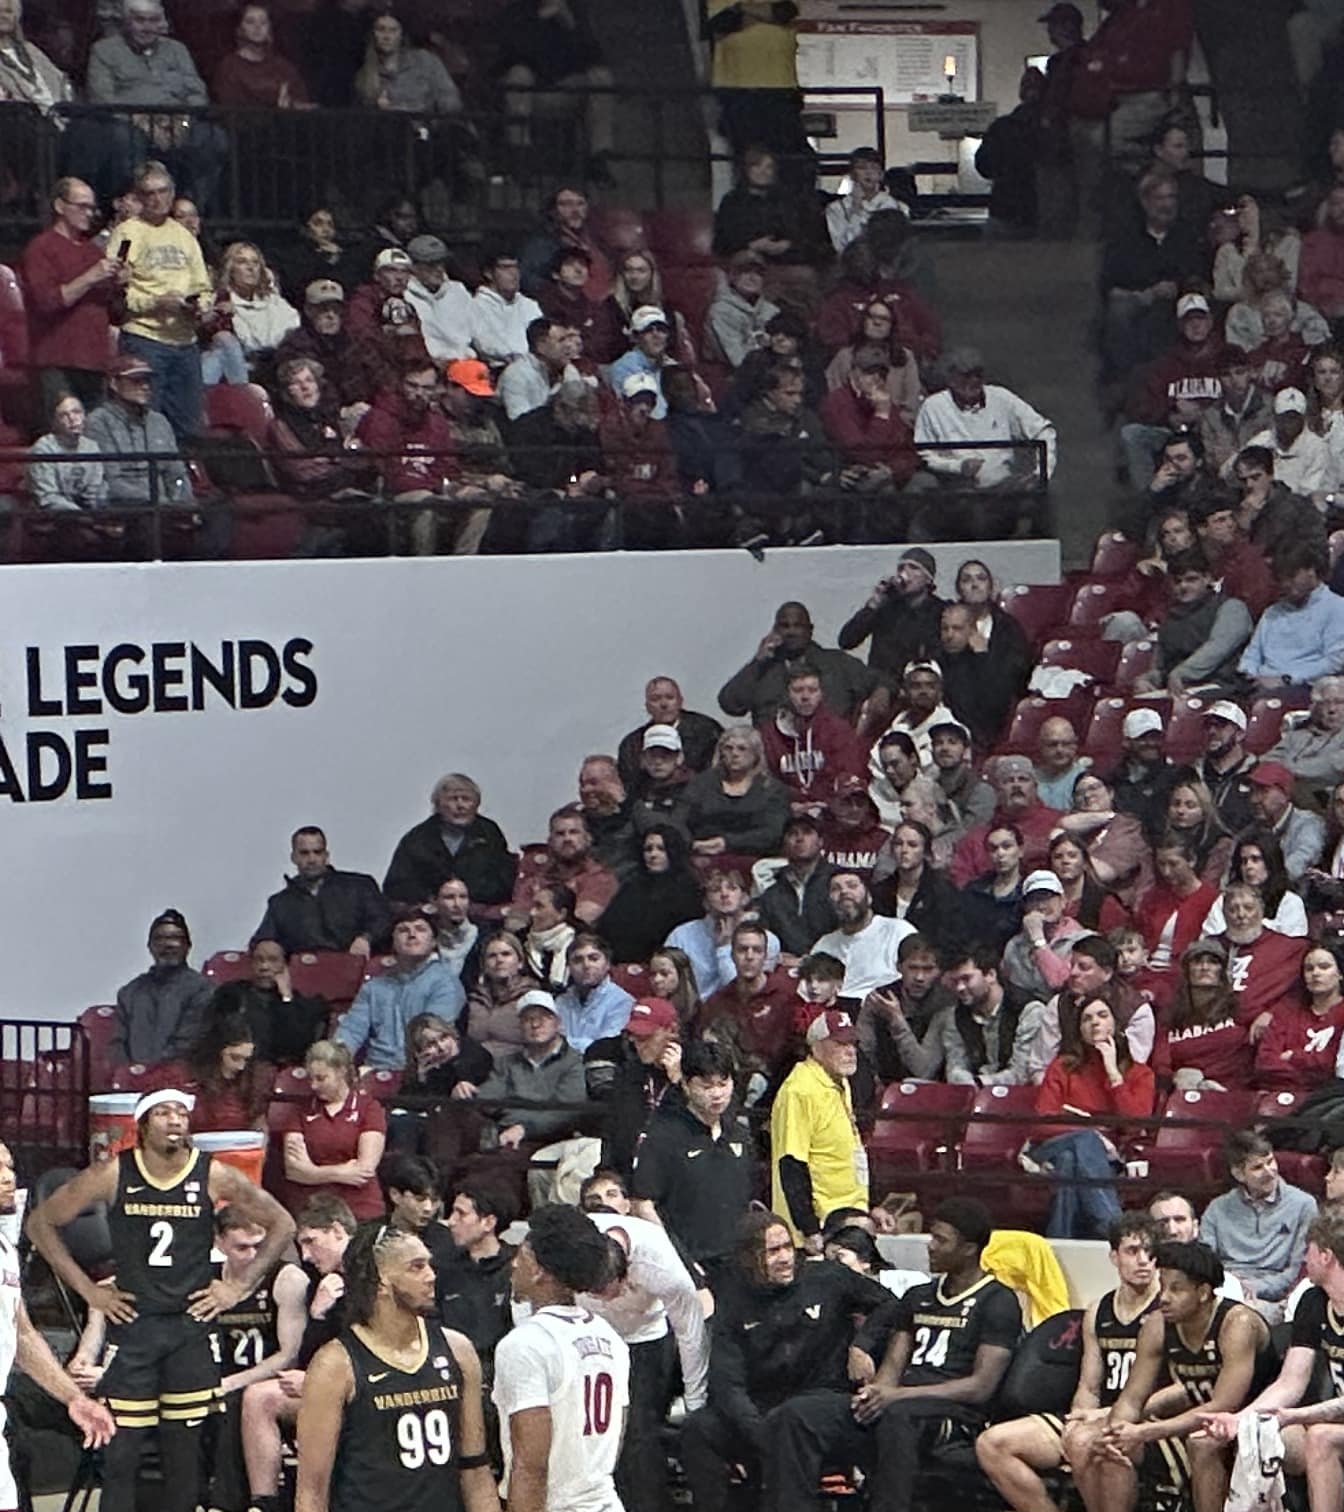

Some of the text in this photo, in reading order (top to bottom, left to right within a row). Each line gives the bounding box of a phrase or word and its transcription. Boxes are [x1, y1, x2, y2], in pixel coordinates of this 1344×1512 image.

[26, 638, 318, 716] LEGENDS
[148, 1221, 174, 1267] 2
[911, 1327, 951, 1367] 24
[374, 1386, 459, 1411] VANDERBILT
[583, 1372, 614, 1437] 10
[397, 1409, 451, 1470] 99
